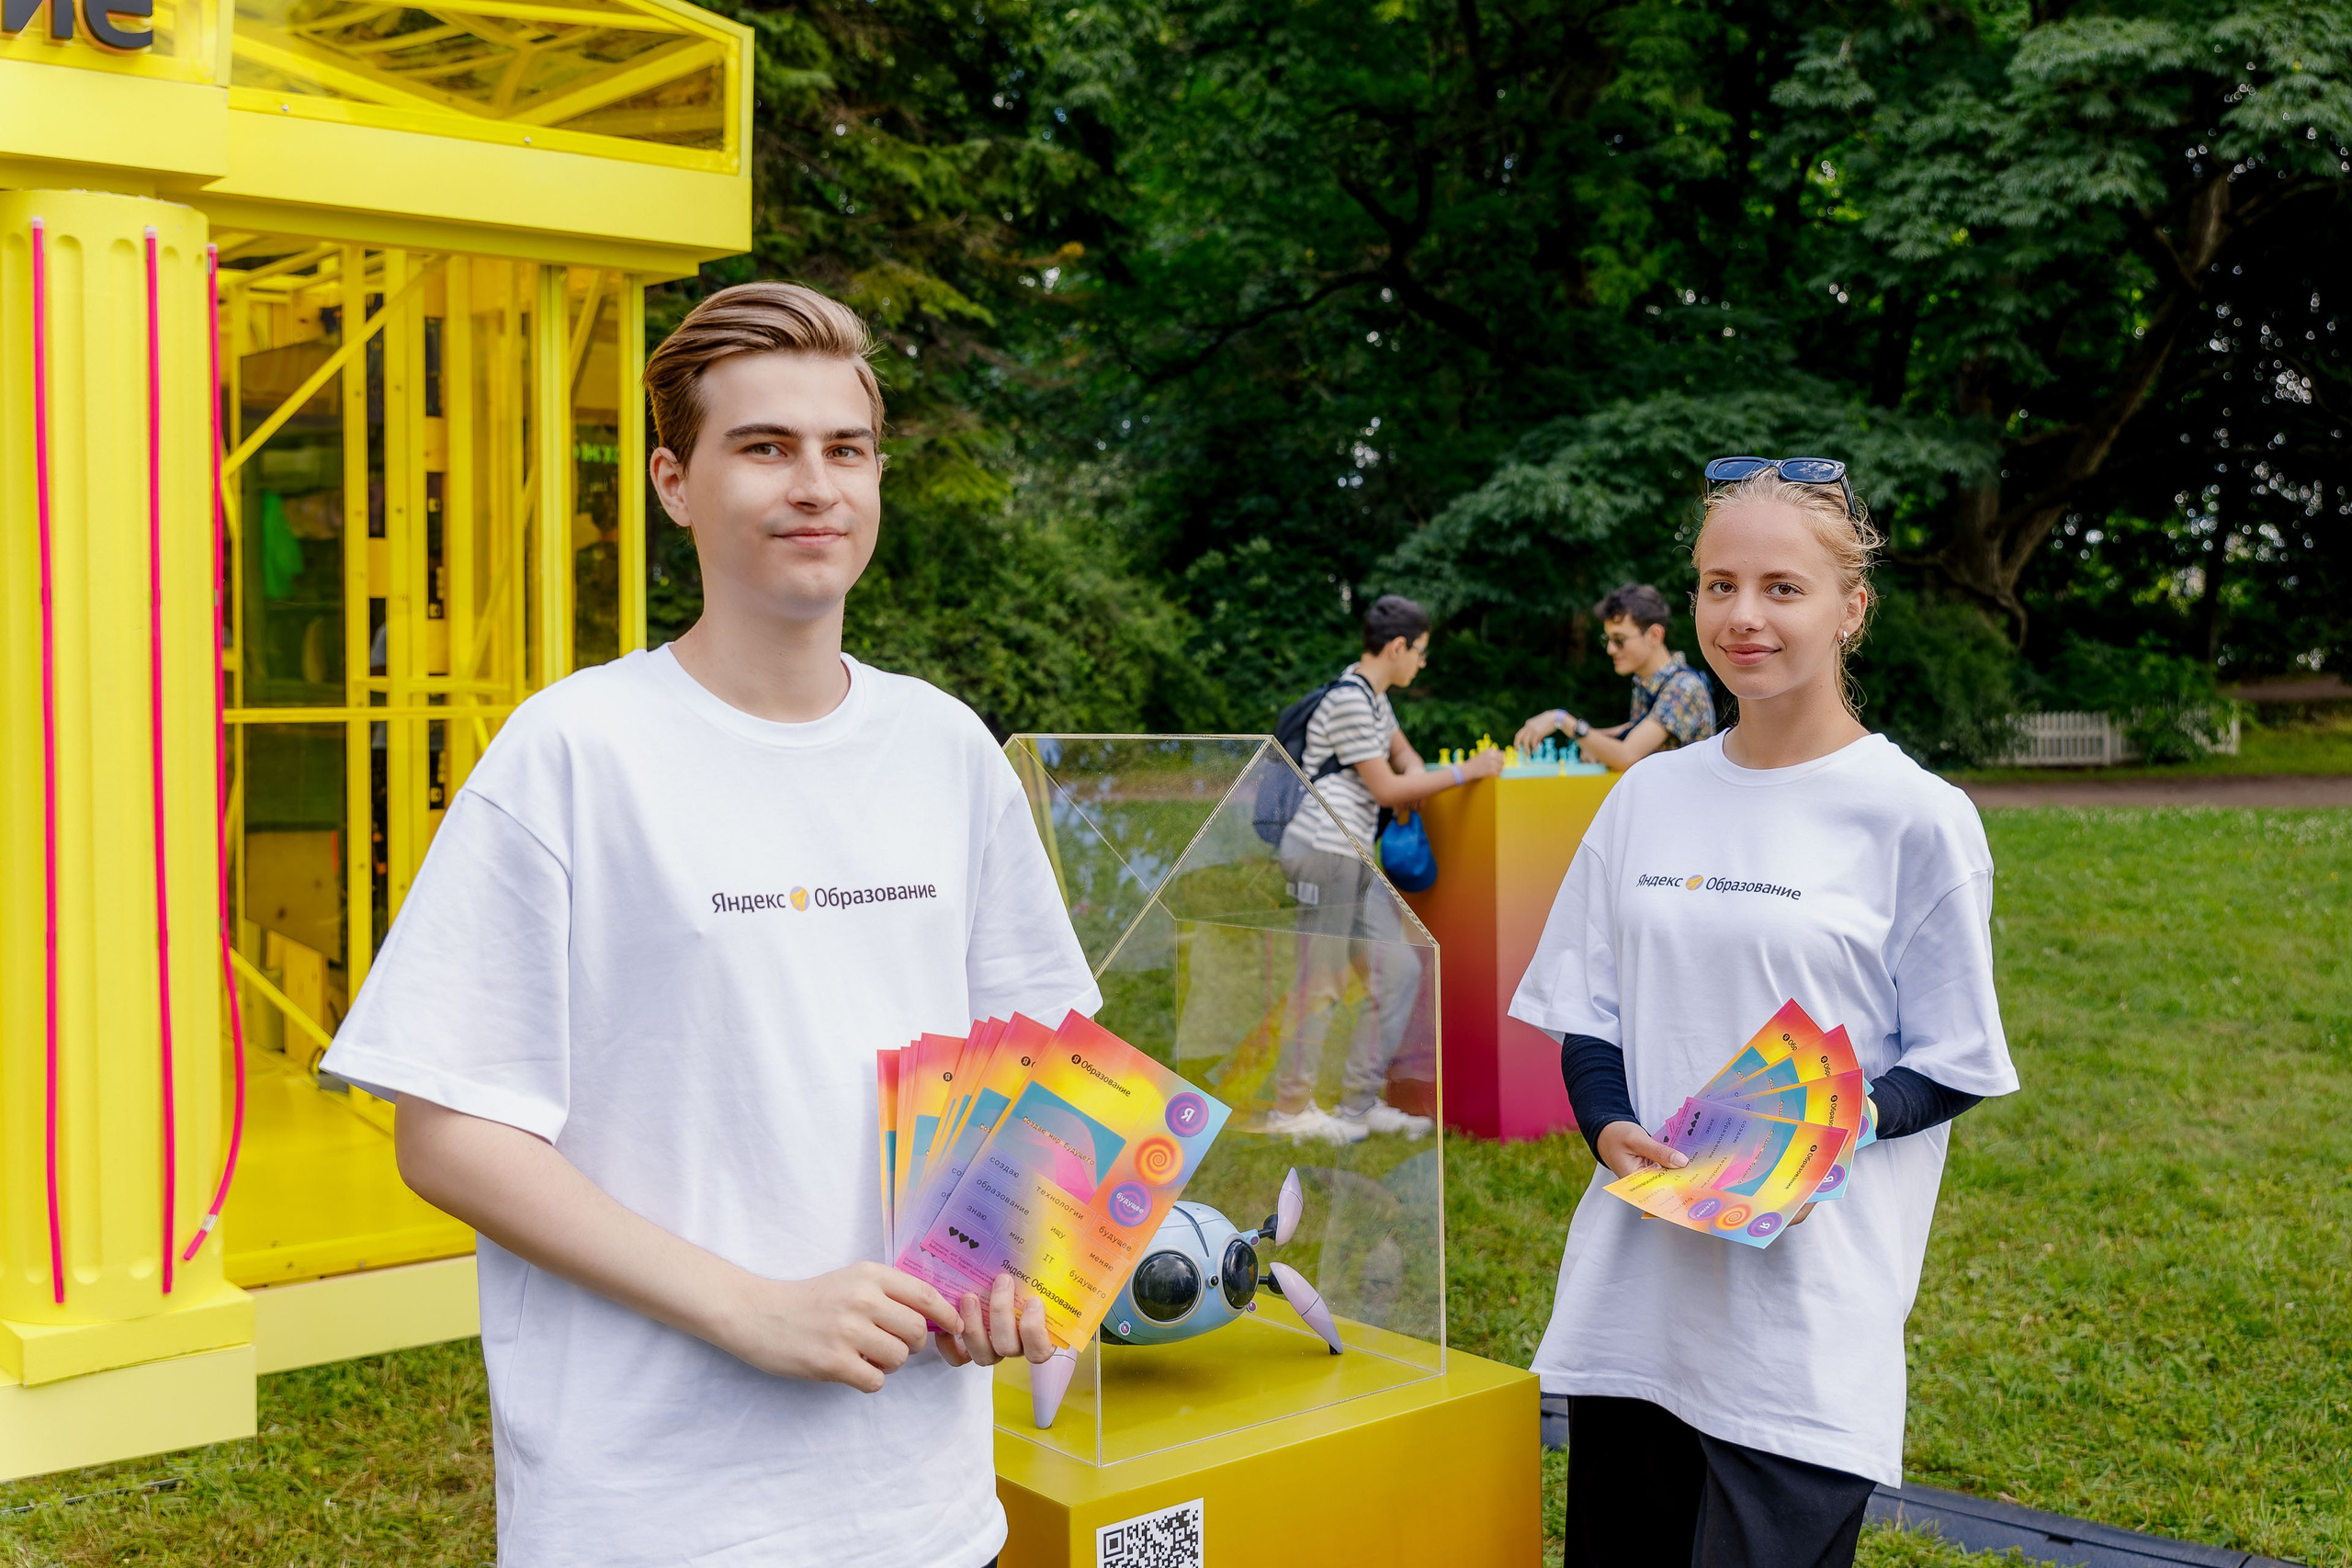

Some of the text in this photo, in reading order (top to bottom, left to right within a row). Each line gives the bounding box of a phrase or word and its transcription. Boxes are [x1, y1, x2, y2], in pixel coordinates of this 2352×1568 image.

[711, 884, 937, 913] Яндекс Образование
[1636, 874, 1802, 900] Яндекс Образование
[1080, 1060, 1131, 1097] Образование
[1181, 1107, 1195, 1122] Я
[989, 1156, 1020, 1179] создаю
[976, 1178, 1030, 1216] образование
[1036, 1185, 1084, 1220] технологии
[1115, 1191, 1145, 1215] будущее
[967, 1204, 988, 1221] знаю
[1009, 1231, 1025, 1246] мир
[1050, 1225, 1067, 1240] ищу
[1098, 1225, 1133, 1252] будущее
[1089, 1252, 1114, 1272] меняю
[1001, 1258, 1031, 1283] Яндекс
[1031, 1278, 1082, 1319] Образование
[1069, 1269, 1107, 1299] будущего
